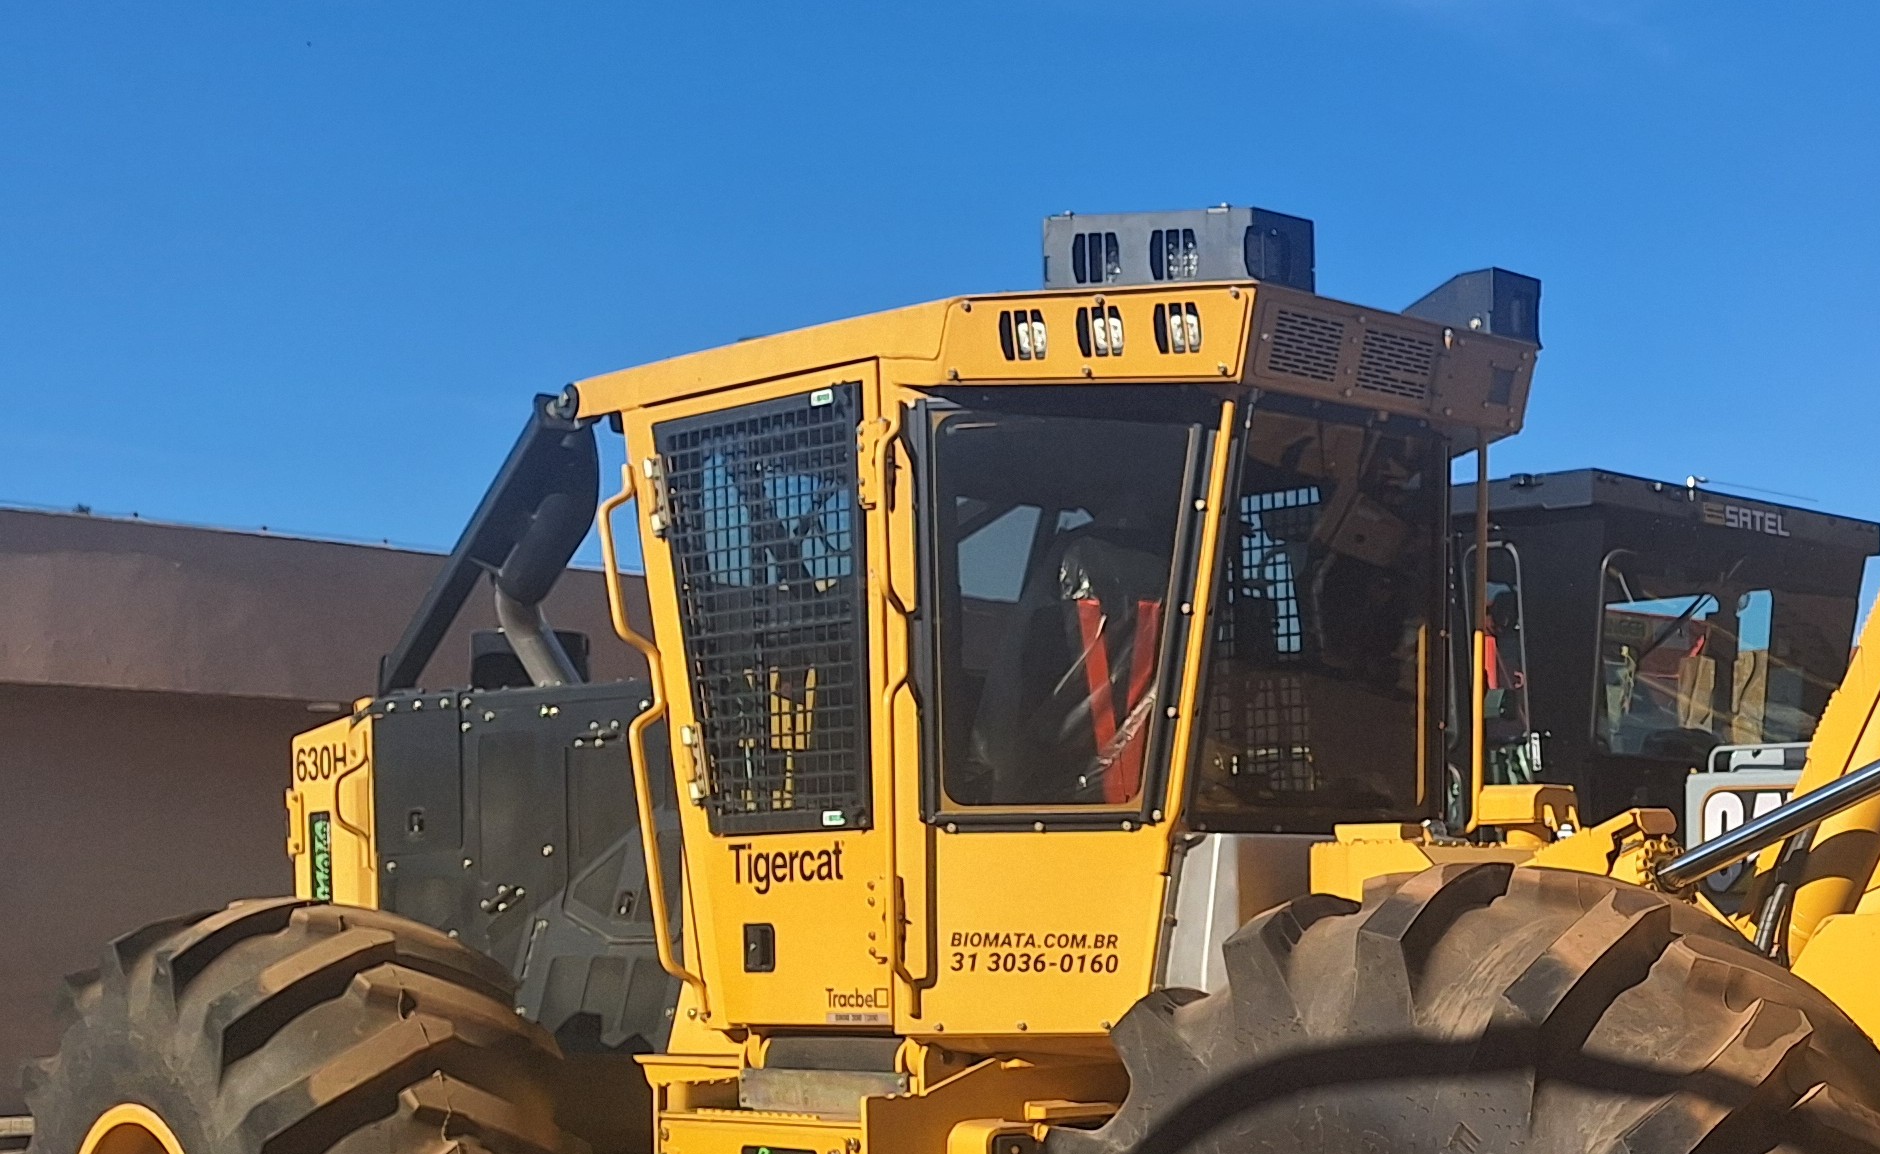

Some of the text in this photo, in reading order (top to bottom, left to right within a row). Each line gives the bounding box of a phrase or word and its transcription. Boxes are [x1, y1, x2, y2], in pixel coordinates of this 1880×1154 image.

[1725, 504, 1790, 537] SATEL
[296, 742, 347, 782] 630H
[728, 840, 844, 895] Tigercat
[950, 931, 1119, 950] BIOMATA.COM.BR
[949, 952, 1119, 974] 31 3036-0160
